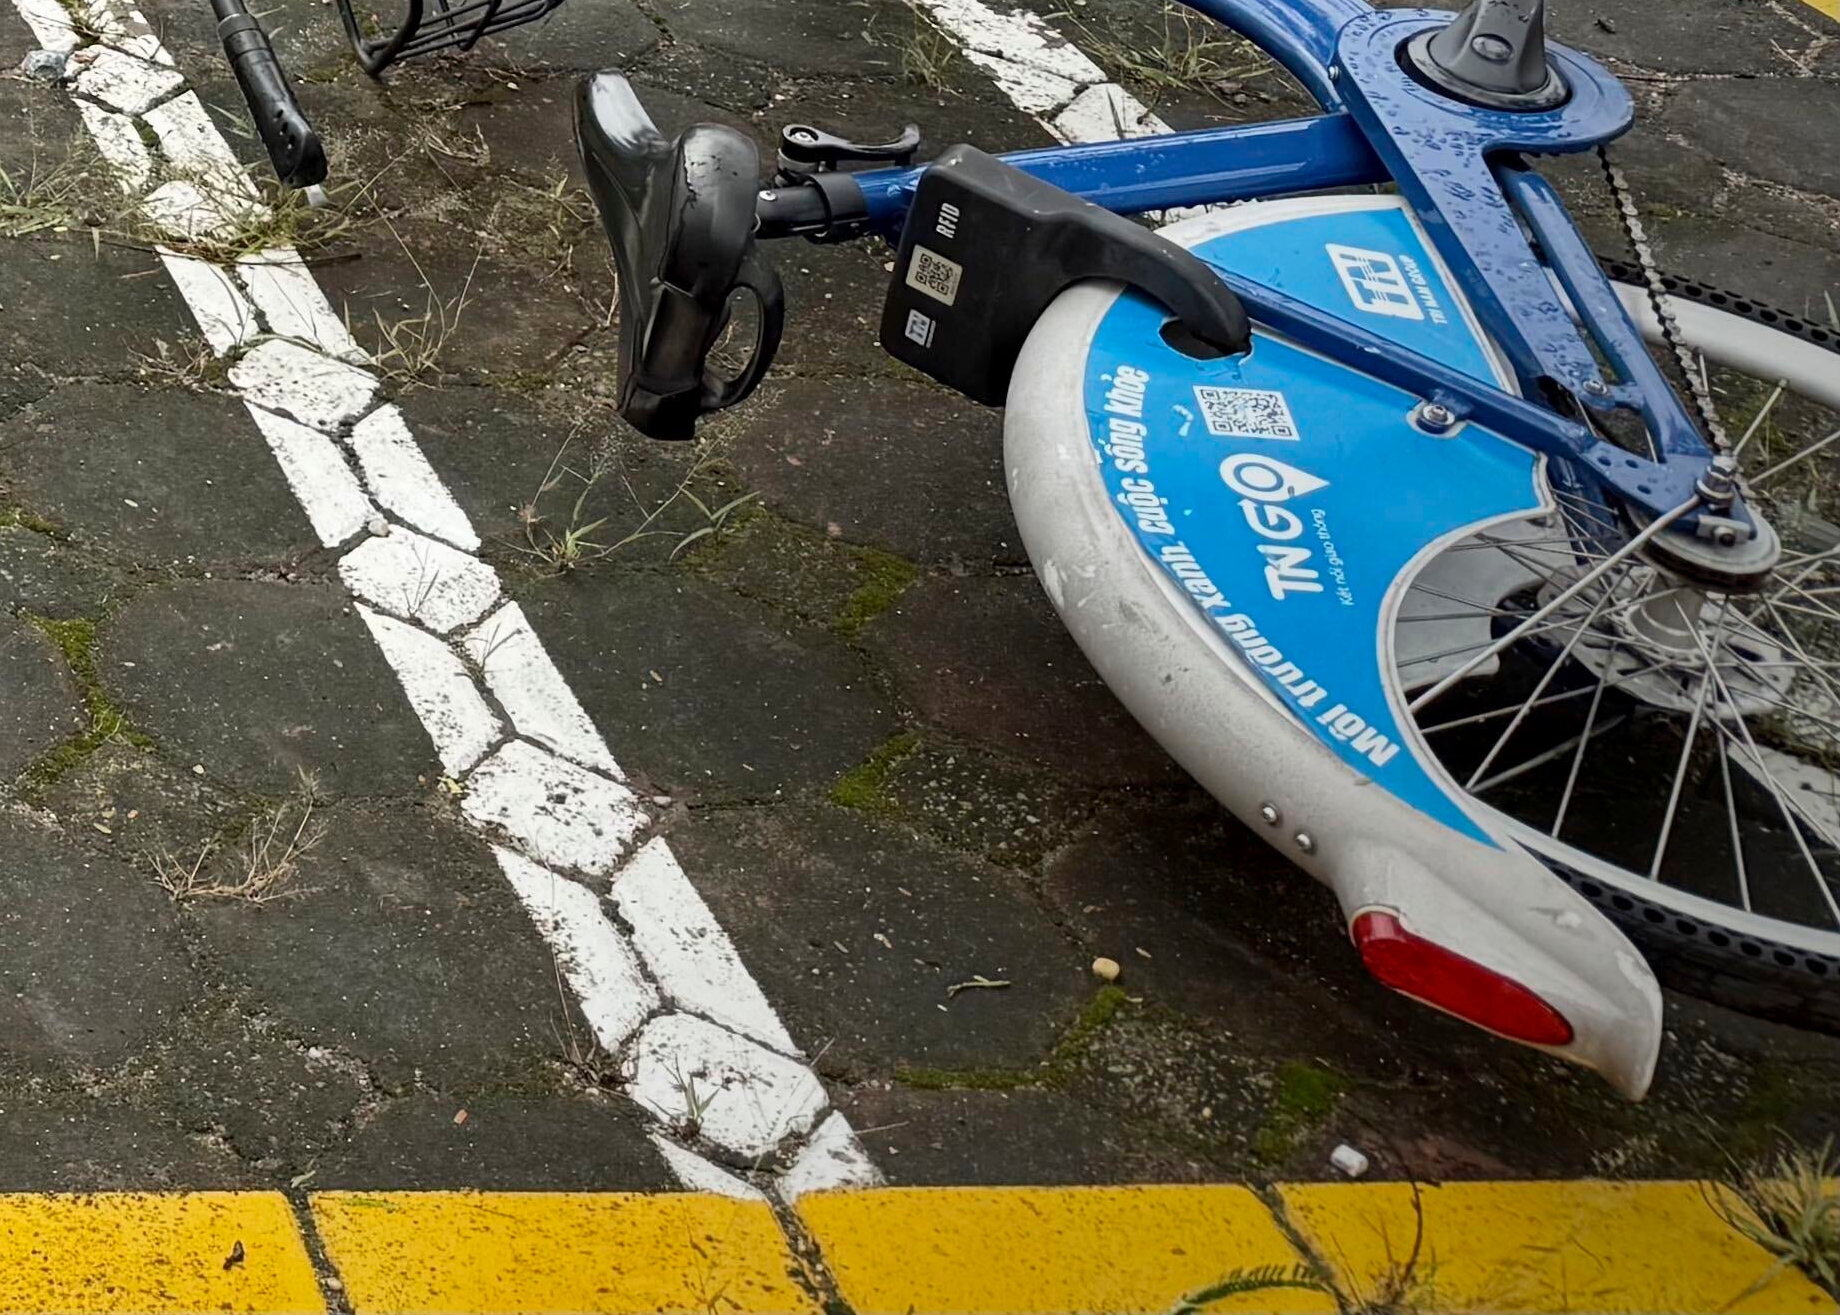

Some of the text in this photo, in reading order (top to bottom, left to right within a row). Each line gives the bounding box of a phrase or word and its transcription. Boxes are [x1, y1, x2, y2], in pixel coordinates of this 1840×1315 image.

[935, 202, 961, 239] RFID
[1097, 417, 1149, 474] sống
[1219, 453, 1331, 601] TNGO
[1315, 703, 1401, 768] Môi
